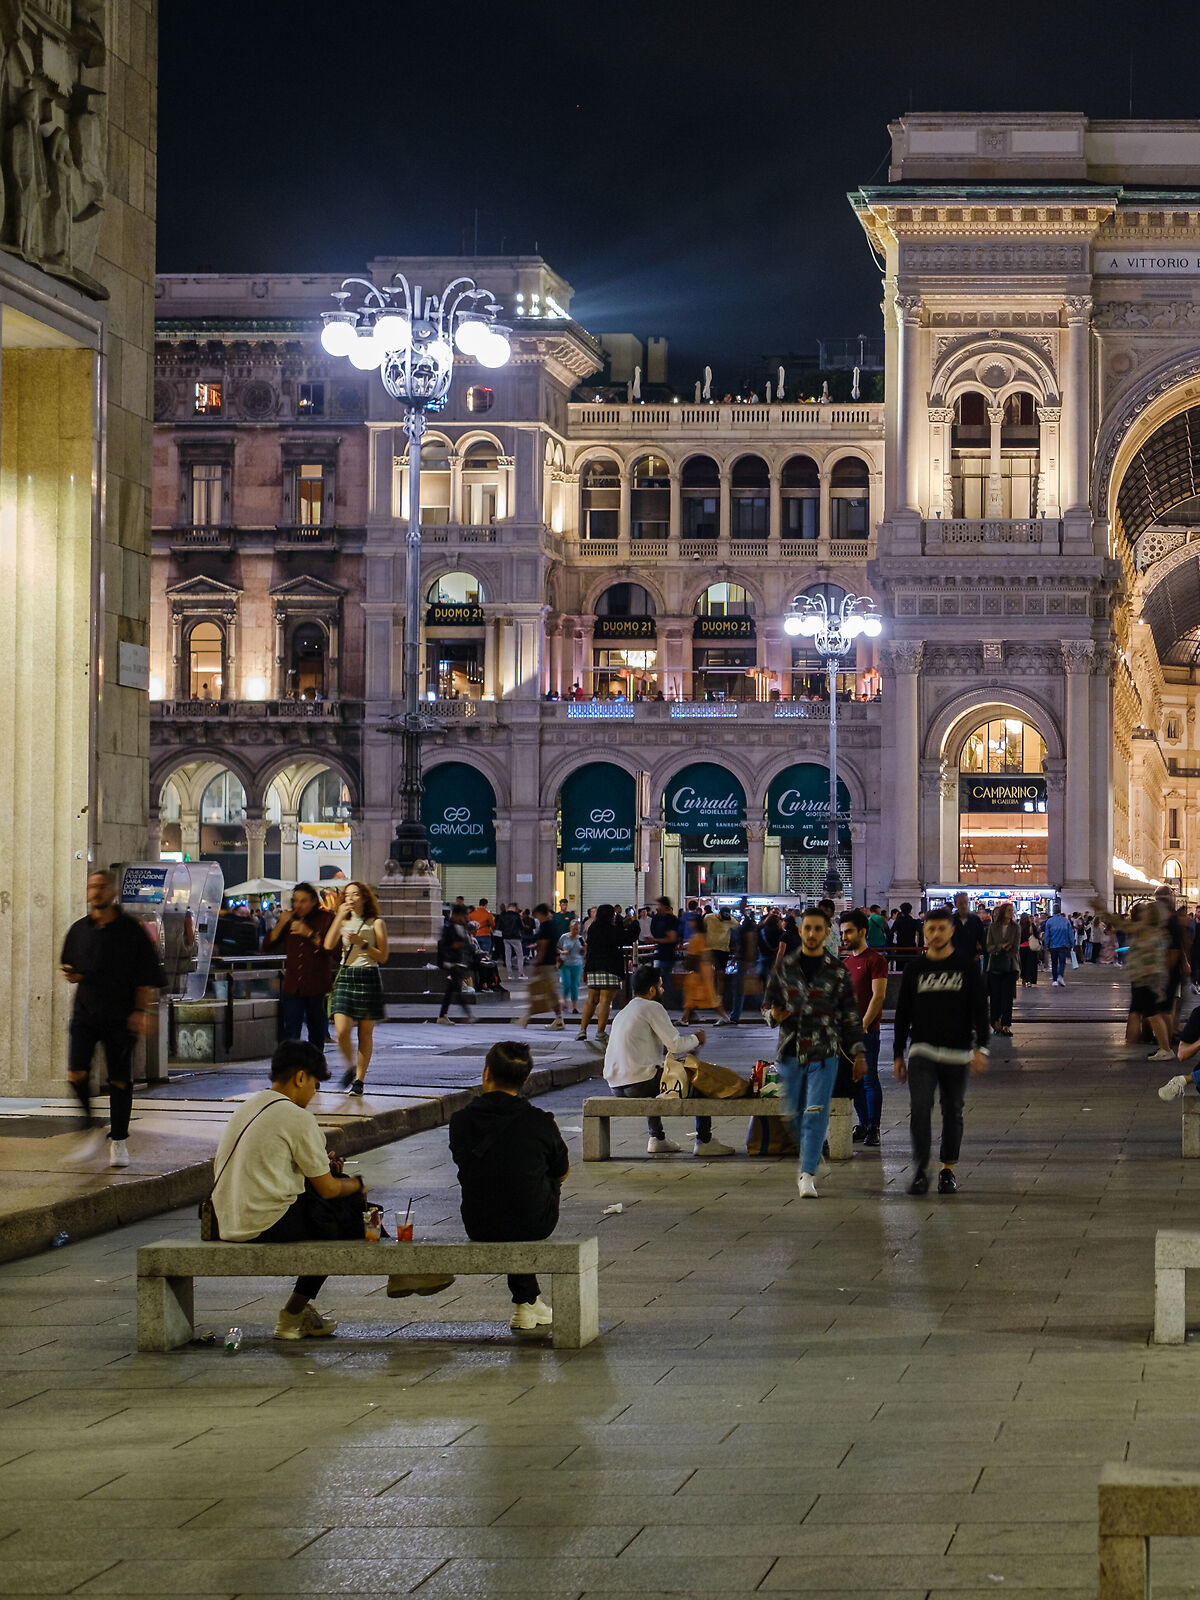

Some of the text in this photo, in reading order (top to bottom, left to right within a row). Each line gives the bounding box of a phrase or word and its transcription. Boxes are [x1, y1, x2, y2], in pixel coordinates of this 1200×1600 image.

[1110, 258, 1119, 268] A
[1127, 258, 1189, 268] VITTORIO
[435, 608, 482, 618] DUOMO 21
[603, 621, 651, 631] DUOMO 21
[702, 621, 750, 631] DUOMO 21
[973, 786, 1038, 799] CAMPARINO
[672, 786, 739, 814] Currado
[430, 823, 484, 835] GRIMOLDI
[575, 827, 631, 839] GRIMOLDI
[703, 833, 740, 848] Currado
